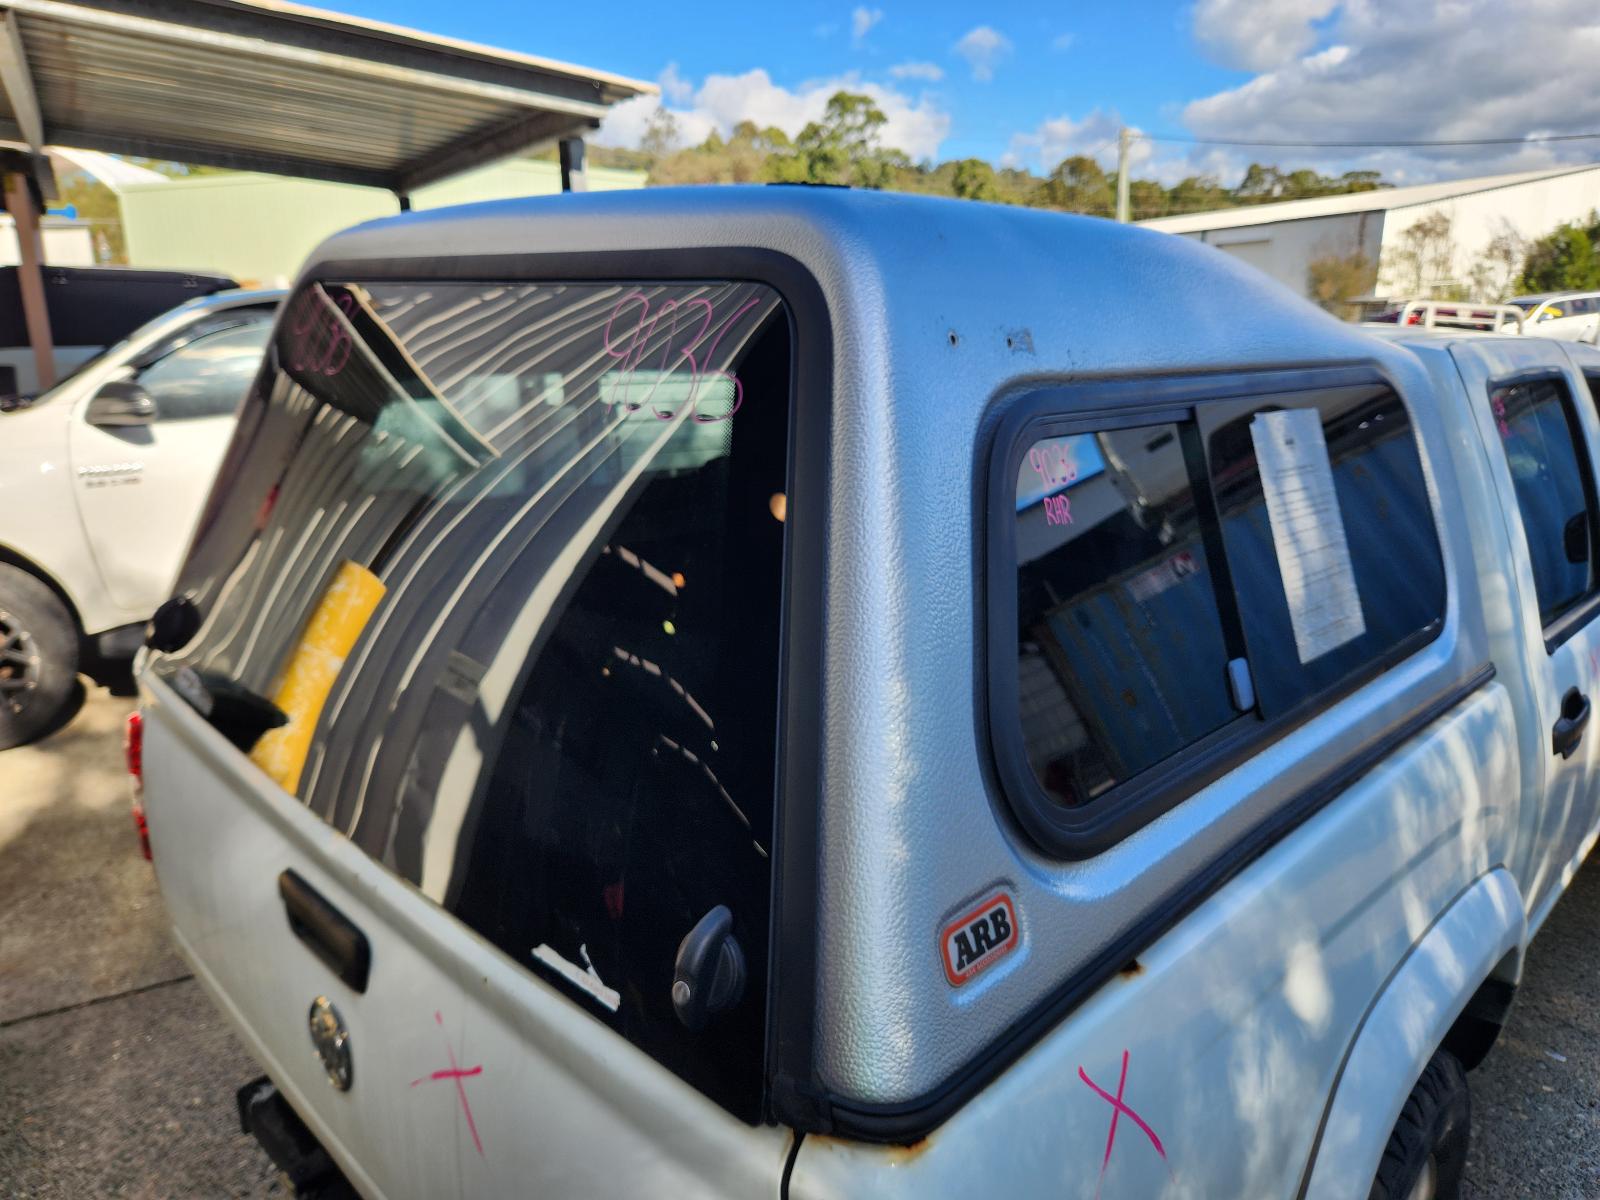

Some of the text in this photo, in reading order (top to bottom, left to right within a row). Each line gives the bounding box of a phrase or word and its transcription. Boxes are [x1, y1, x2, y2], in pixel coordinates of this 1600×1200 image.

[603, 291, 761, 425] 9036
[1043, 494, 1073, 527] RHR
[953, 906, 1011, 972] ARB
